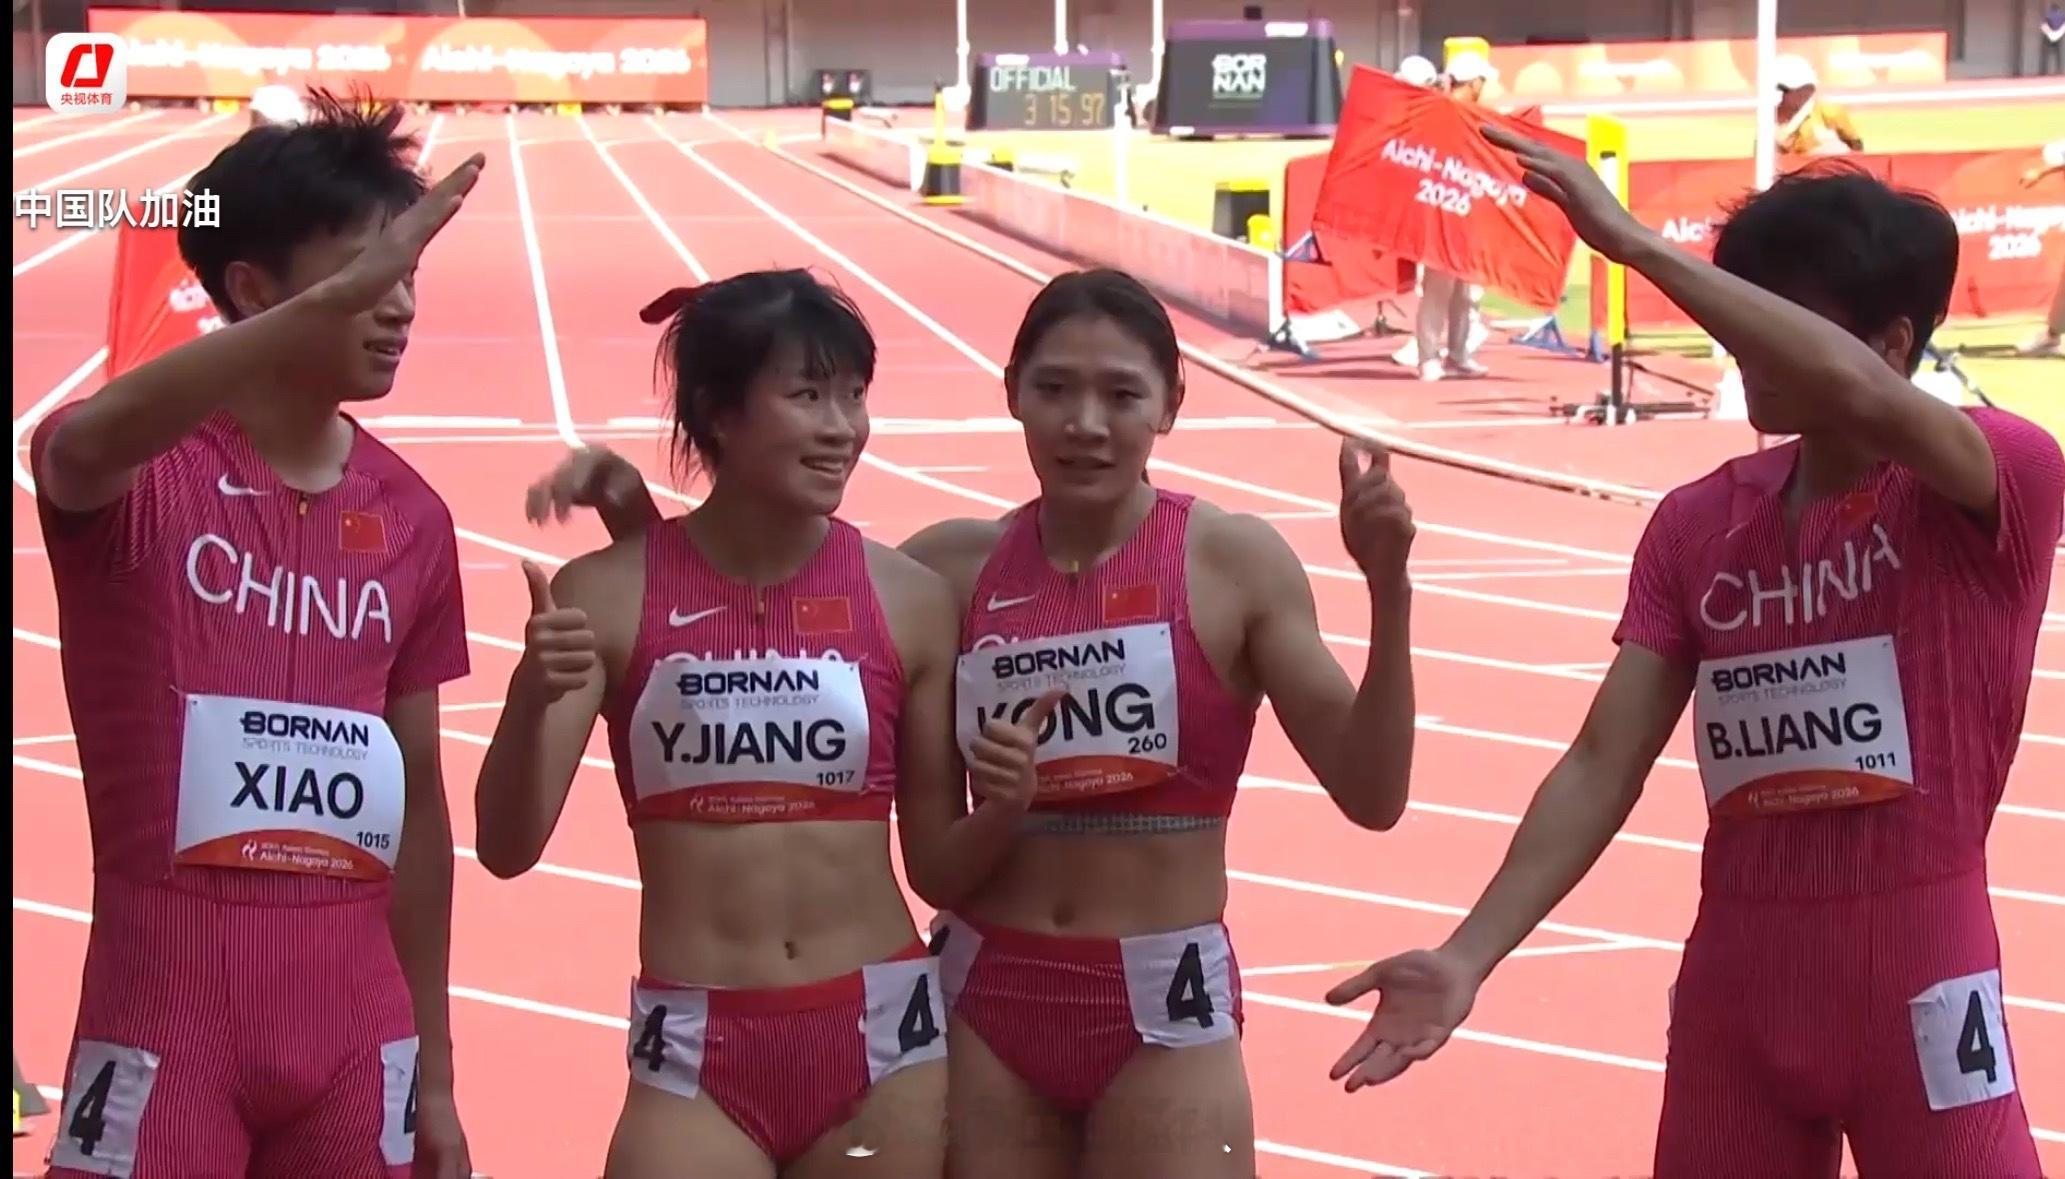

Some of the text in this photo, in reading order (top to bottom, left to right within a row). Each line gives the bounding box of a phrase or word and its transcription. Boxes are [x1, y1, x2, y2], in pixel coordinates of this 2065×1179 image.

[990, 66, 1077, 92] OFFICIAL
[1381, 138, 1528, 207] Aichi-Nagoya
[1415, 178, 1472, 217] 2026
[187, 534, 392, 643] CHINA
[1701, 523, 1901, 630] CHINA
[676, 669, 819, 696] BORNAN
[991, 639, 1126, 679] BORNAN
[1712, 652, 1846, 692] BORNAN
[240, 711, 369, 747] BORNAN
[651, 718, 847, 765] Y.JIANG
[1127, 733, 1168, 755] 260
[1706, 702, 1882, 760] B.LIANG
[816, 770, 855, 786] 1017
[1855, 752, 1896, 770] 1011
[230, 761, 364, 819] XIAO
[356, 831, 390, 849] 1015
[1166, 941, 1215, 1029] 4
[898, 973, 940, 1053] 4
[1956, 990, 1997, 1083] 4
[633, 1003, 667, 1073] 4
[69, 1060, 116, 1155] 4
